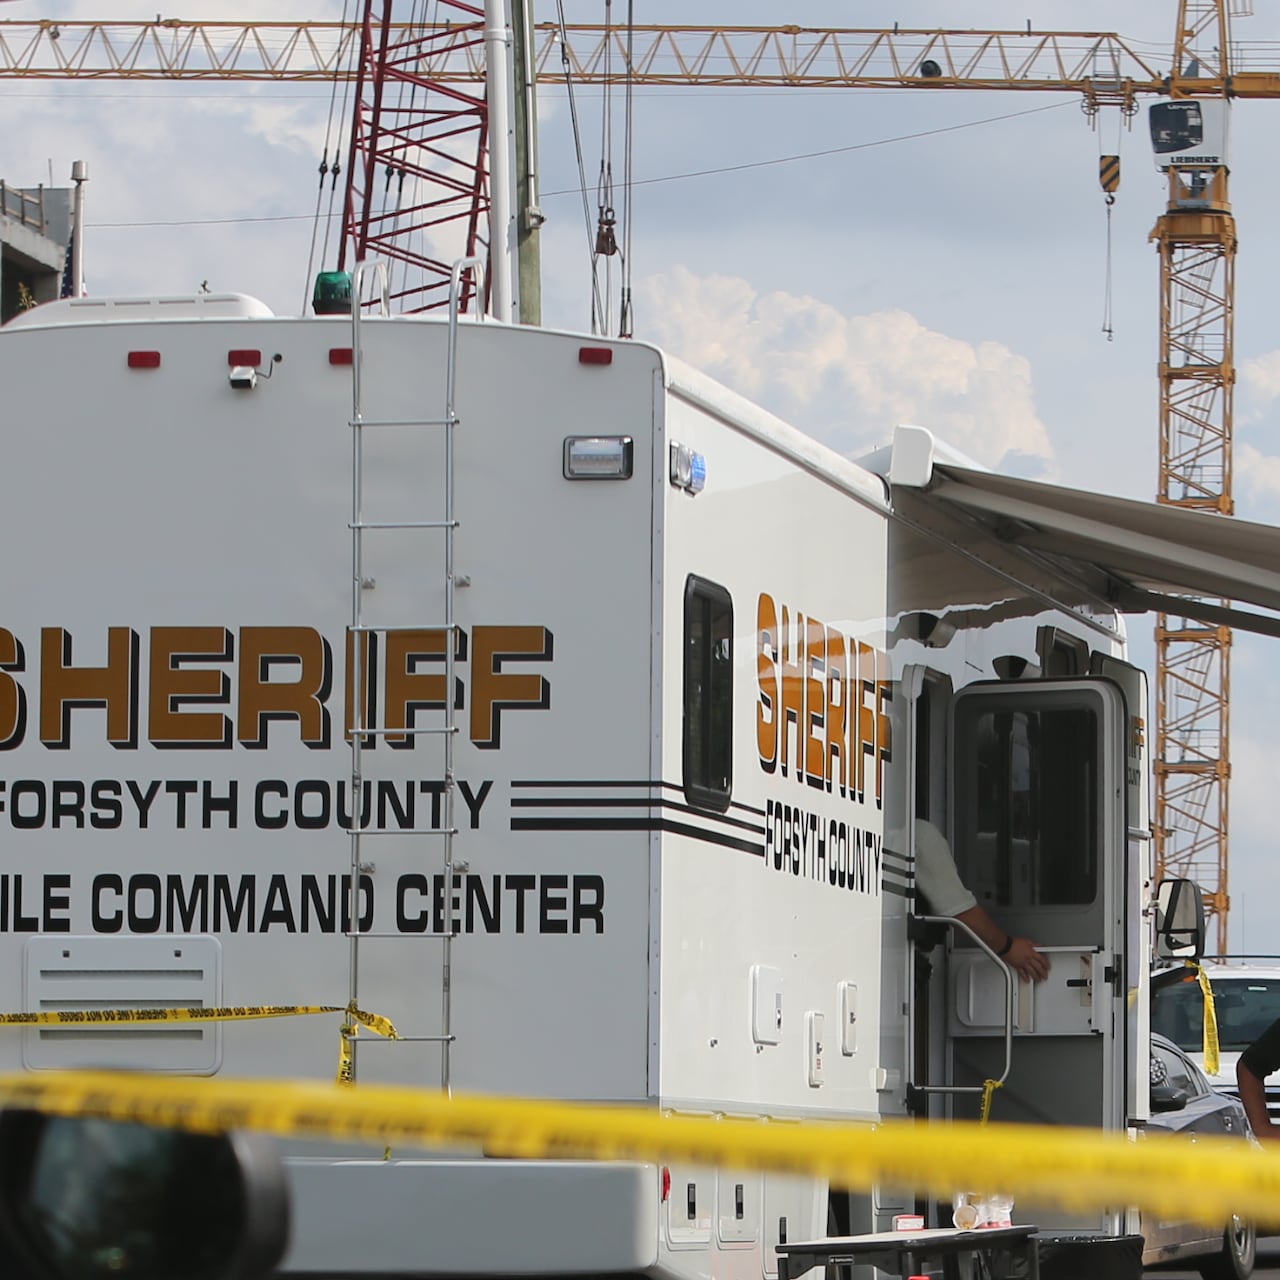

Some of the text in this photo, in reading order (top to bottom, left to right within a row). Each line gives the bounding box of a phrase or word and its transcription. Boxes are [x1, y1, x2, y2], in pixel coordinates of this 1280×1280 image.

[757, 592, 893, 810] SHERIFF
[254, 779, 494, 829] COUNTY
[765, 798, 882, 897] FORSYTH COUNTY
[91, 873, 374, 933] COMMAND
[396, 873, 604, 934] CENTER
